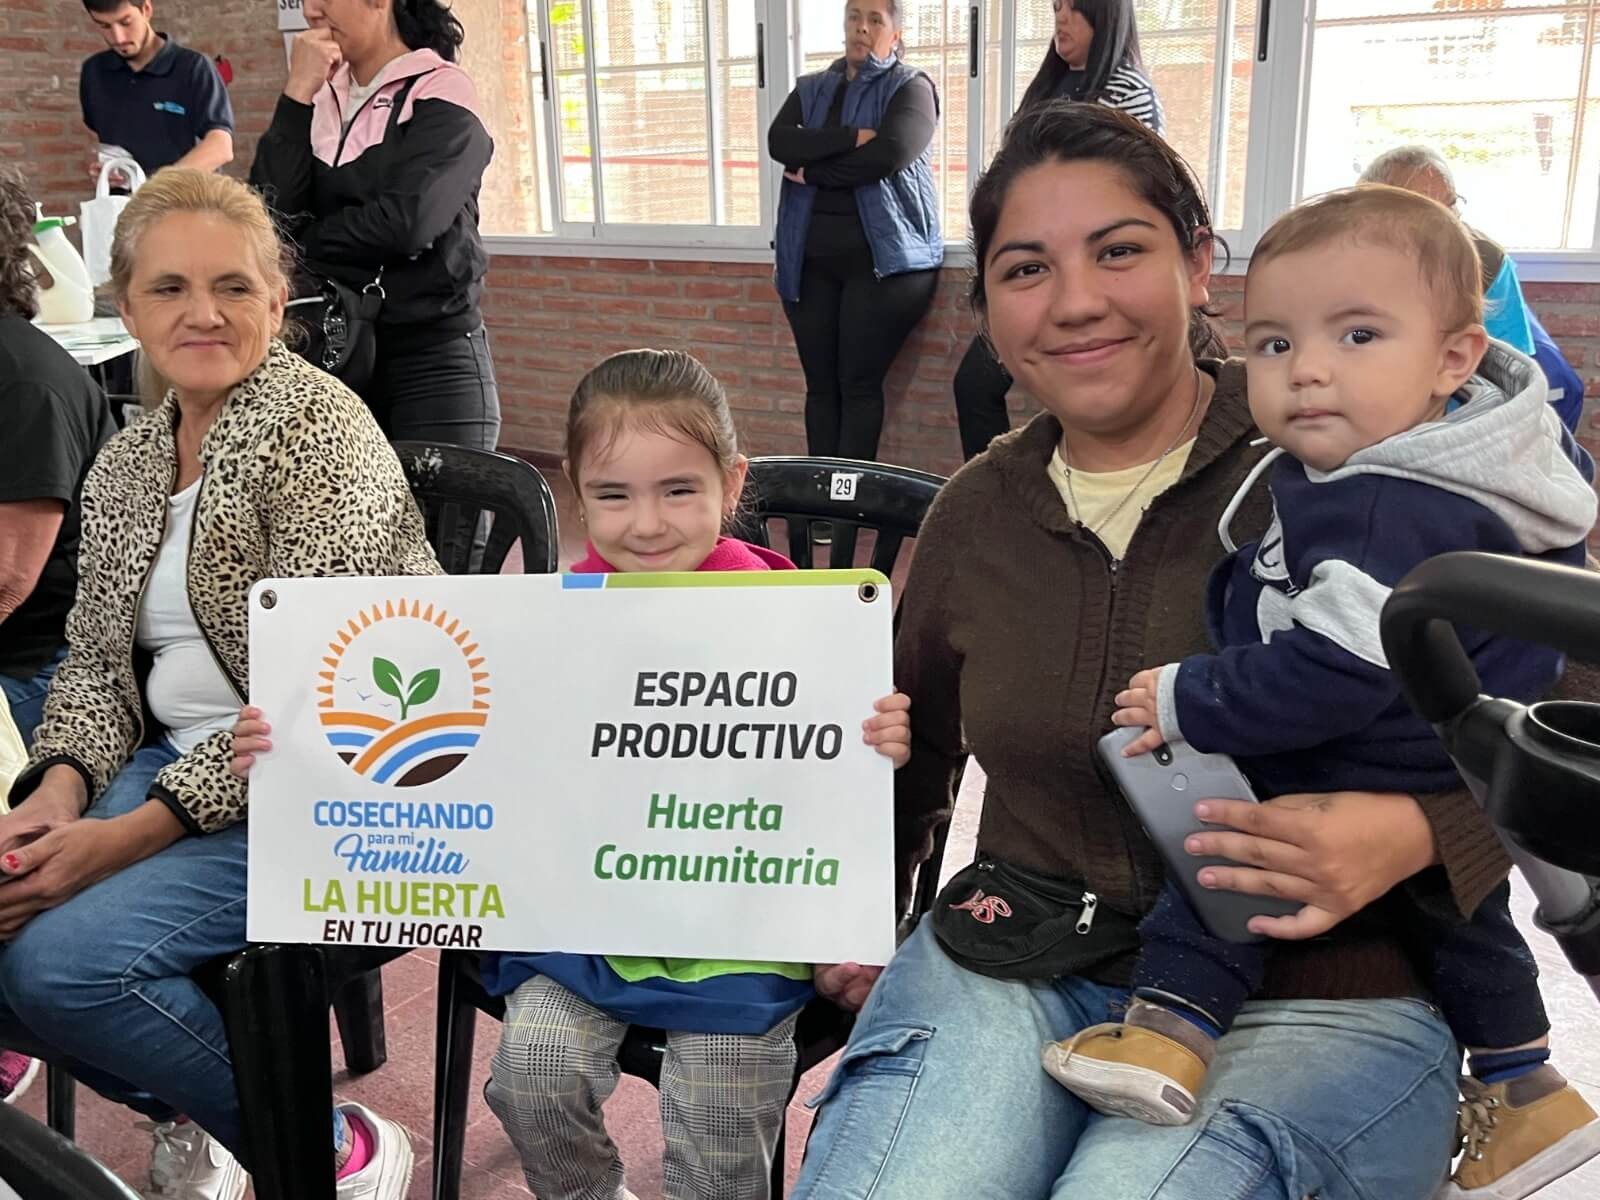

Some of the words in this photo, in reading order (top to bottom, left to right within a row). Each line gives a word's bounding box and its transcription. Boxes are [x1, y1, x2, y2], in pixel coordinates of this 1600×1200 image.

[836, 478, 851, 495] 29
[633, 671, 798, 708] ESPACIO
[590, 722, 843, 760] PRODUCTIVO
[314, 800, 494, 830] COSECHANDO
[647, 793, 783, 831] Huerta
[334, 833, 470, 875] Familia
[367, 834, 395, 847] para
[398, 832, 415, 845] mi
[593, 844, 840, 886] Comunitaria
[303, 878, 347, 913] LA
[357, 880, 505, 919] HUERTA
[323, 919, 354, 942] EN
[362, 921, 392, 944] TU
[398, 922, 483, 948] HOGAR
